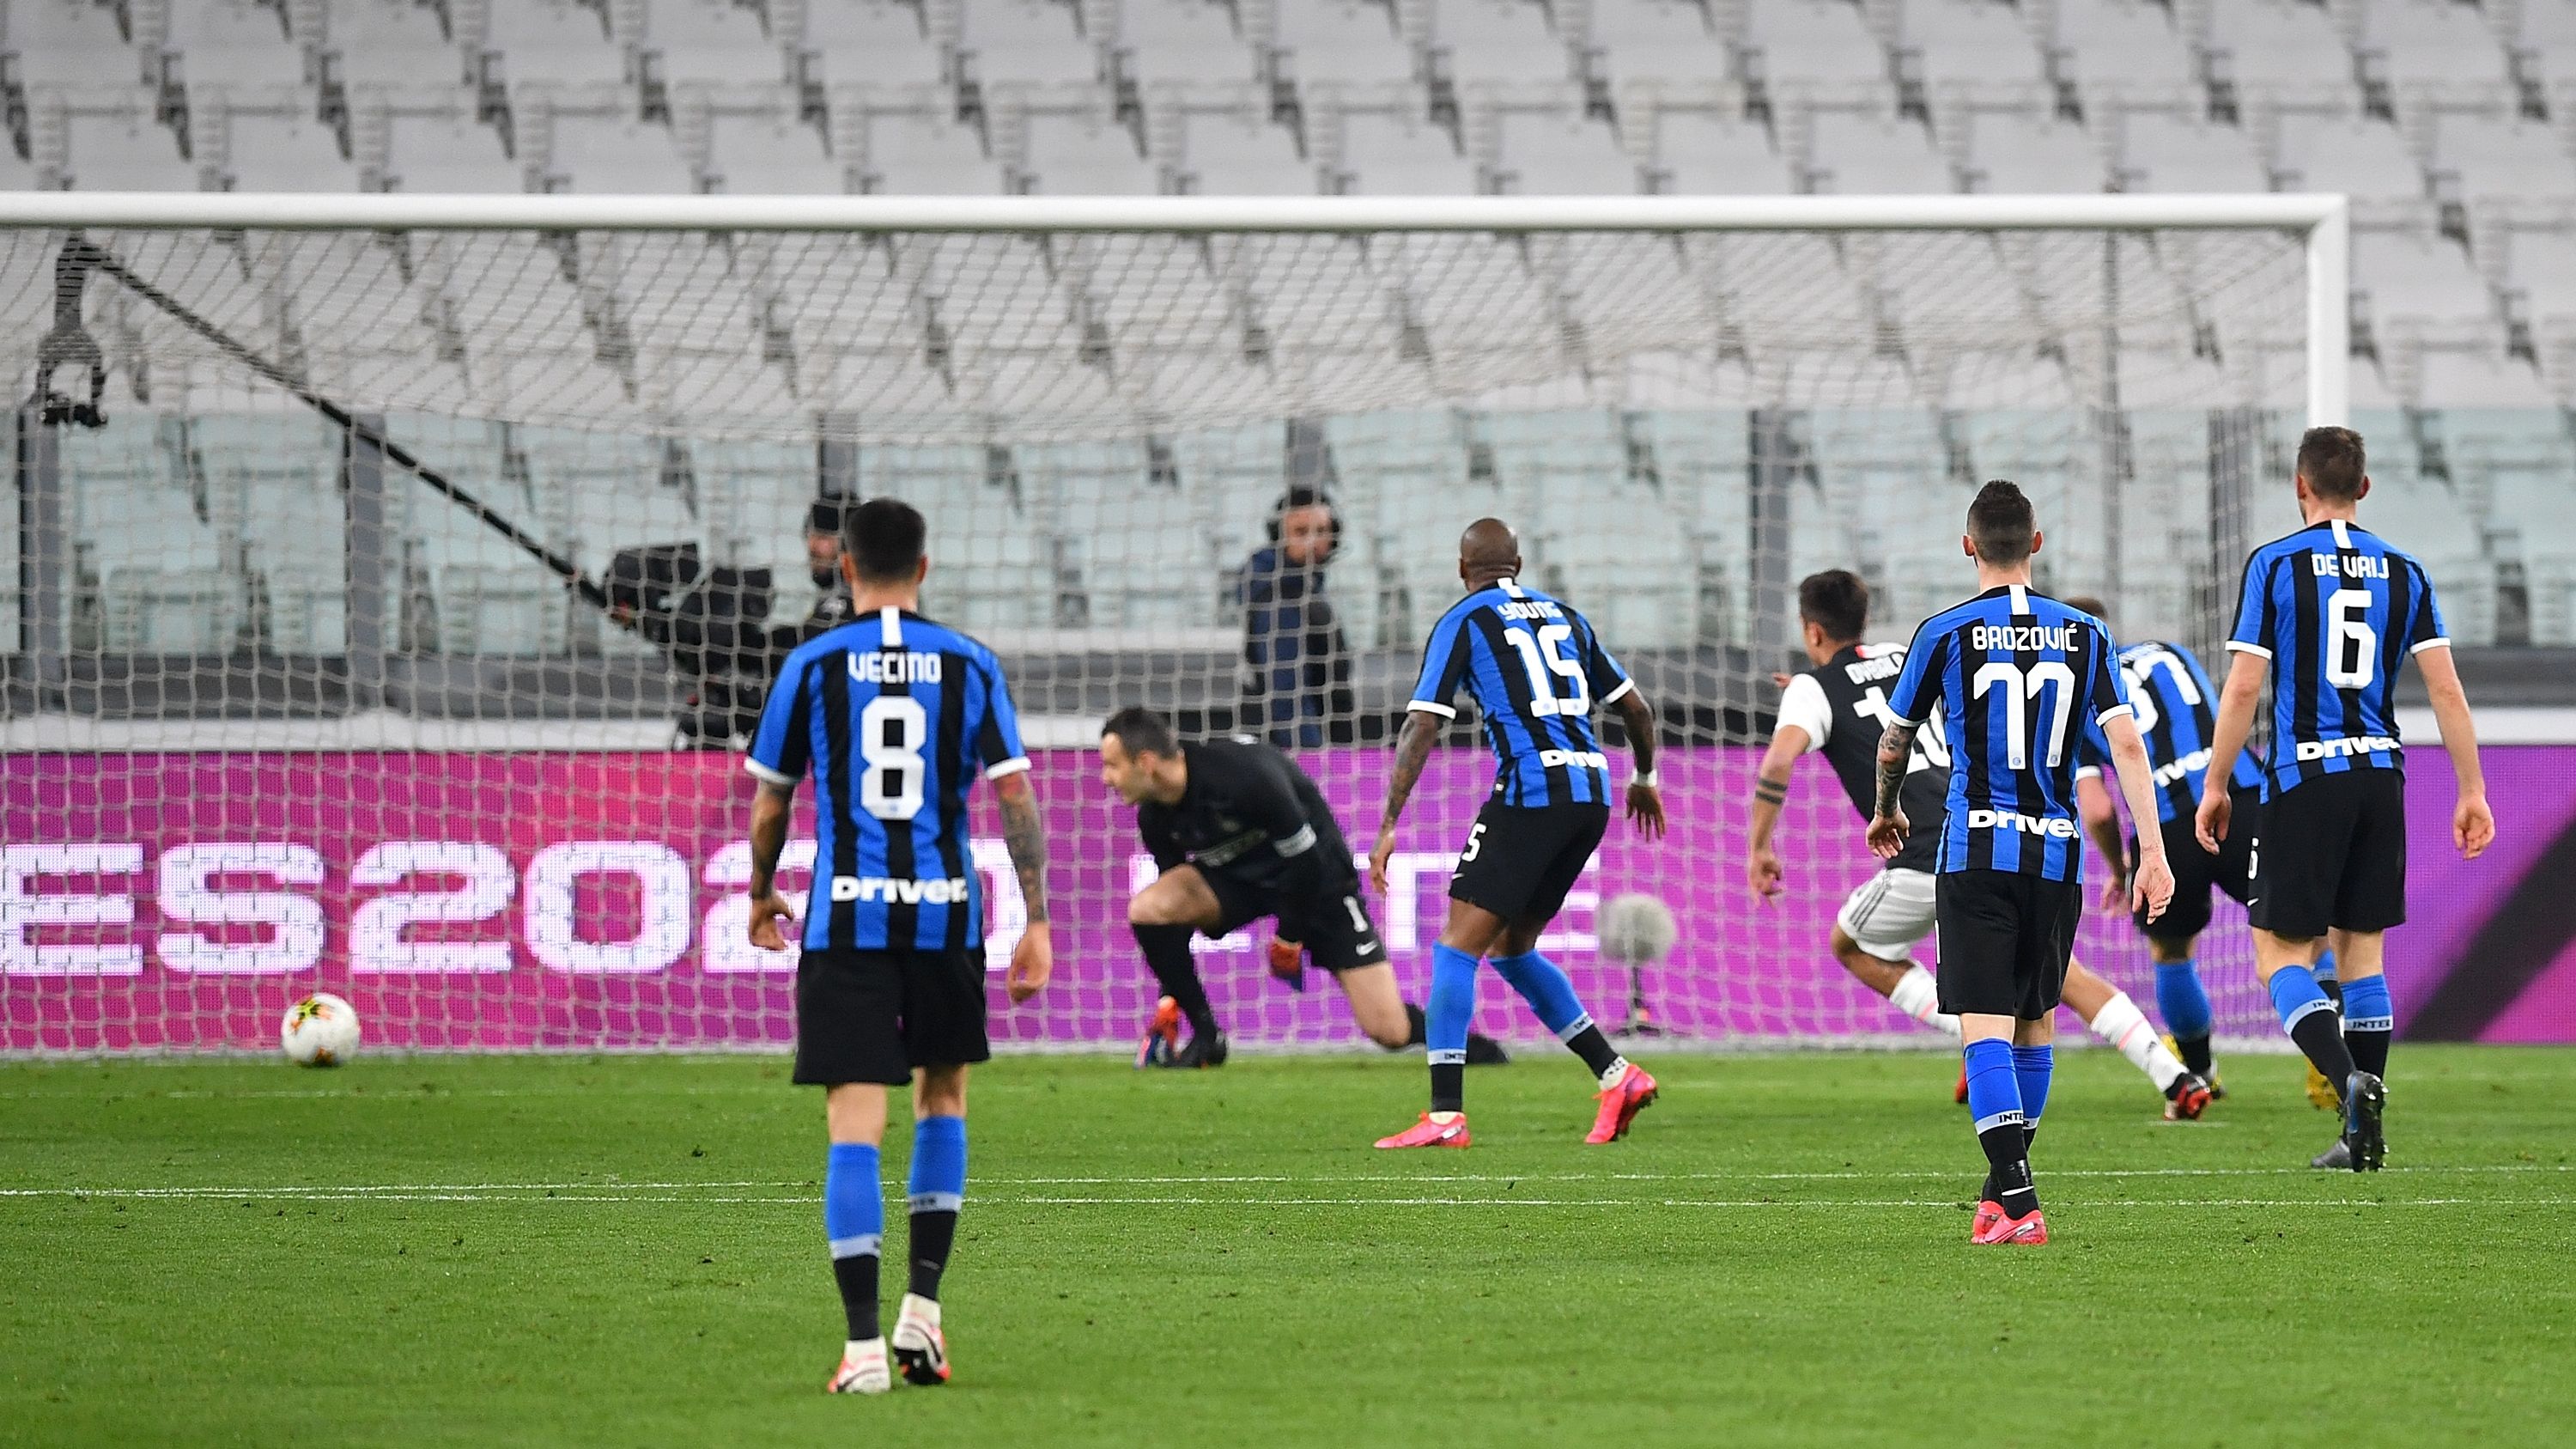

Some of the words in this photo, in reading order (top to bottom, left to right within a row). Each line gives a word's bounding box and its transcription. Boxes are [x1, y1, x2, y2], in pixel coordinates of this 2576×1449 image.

[2312, 553, 2340, 576] DE
[2343, 555, 2390, 578] VRIJ
[1497, 600, 1563, 621] YOUNG
[1972, 622, 2079, 652] BROZOVIĆ
[2325, 588, 2376, 689] 6
[848, 652, 943, 685] VECINO
[1504, 624, 1590, 717] 15
[860, 695, 927, 820] 8
[1342, 895, 1369, 934] 1
[1998, 1112, 2024, 1123] INTE
